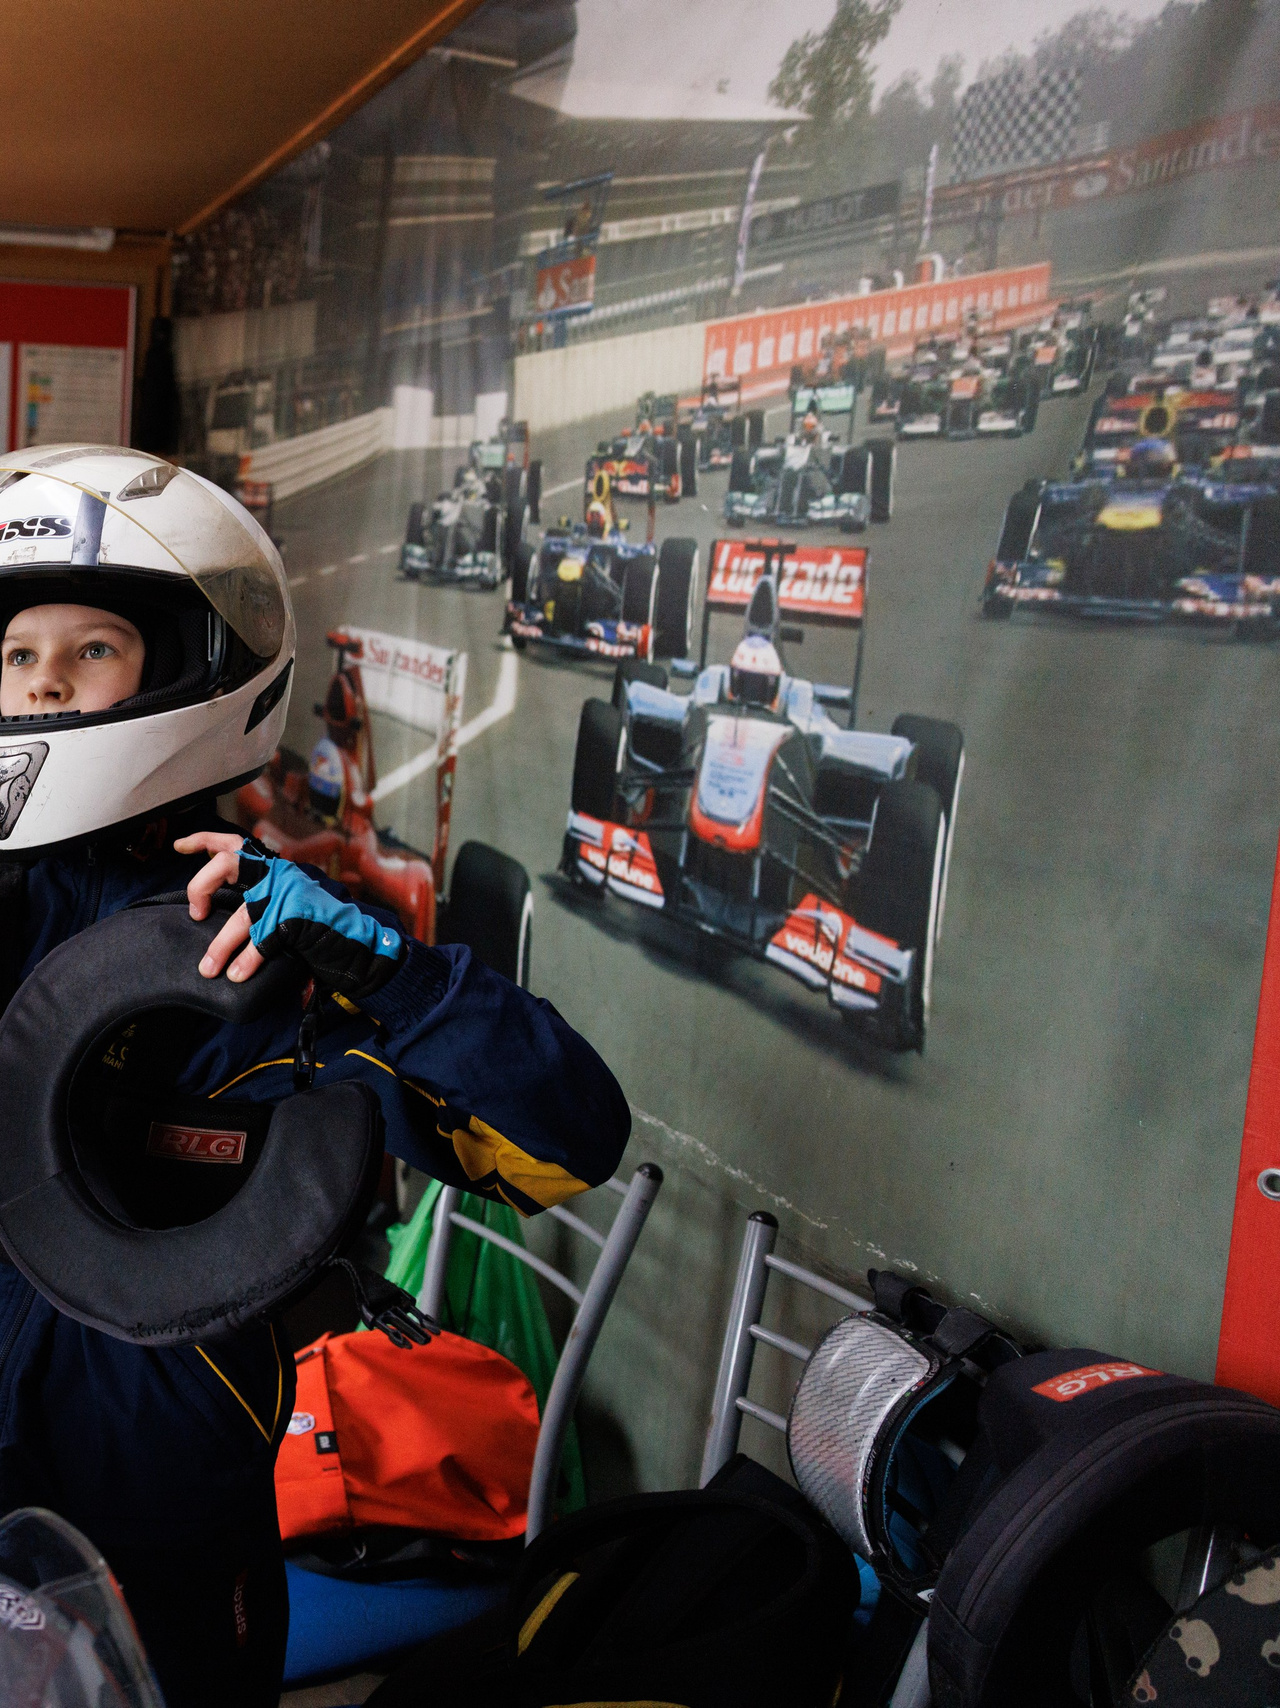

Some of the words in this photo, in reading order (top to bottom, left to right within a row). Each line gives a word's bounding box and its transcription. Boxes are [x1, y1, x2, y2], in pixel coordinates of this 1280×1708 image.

[711, 543, 862, 604] Luczade
[160, 1131, 238, 1156] RLG
[1056, 1366, 1144, 1395] RLG
